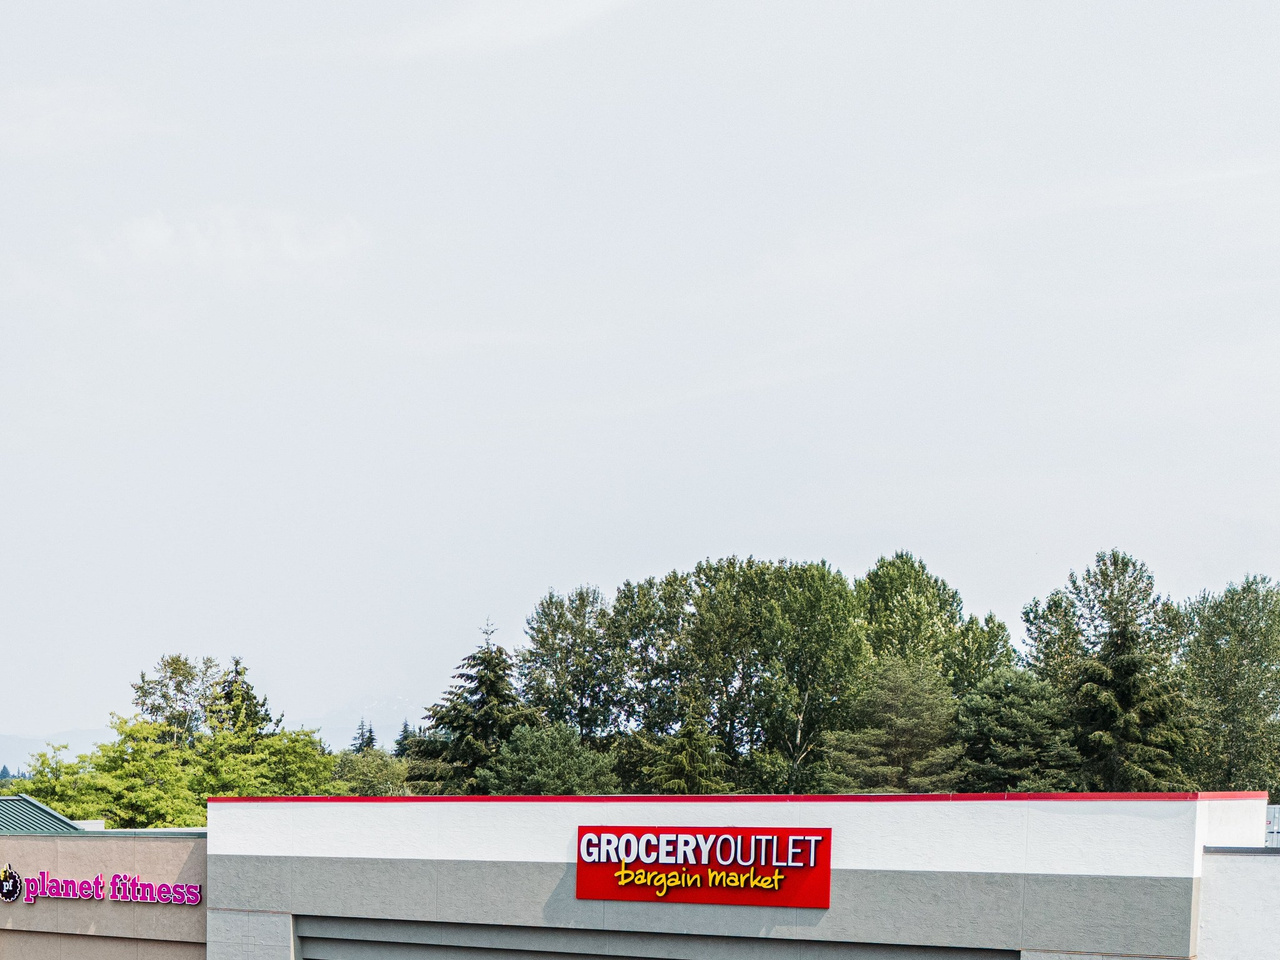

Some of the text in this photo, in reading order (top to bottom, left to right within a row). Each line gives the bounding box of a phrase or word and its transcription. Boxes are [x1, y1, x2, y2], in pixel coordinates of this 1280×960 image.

[2, 879, 14, 893] pf
[23, 869, 202, 906] planet fitness
[613, 858, 785, 897] bargain market
